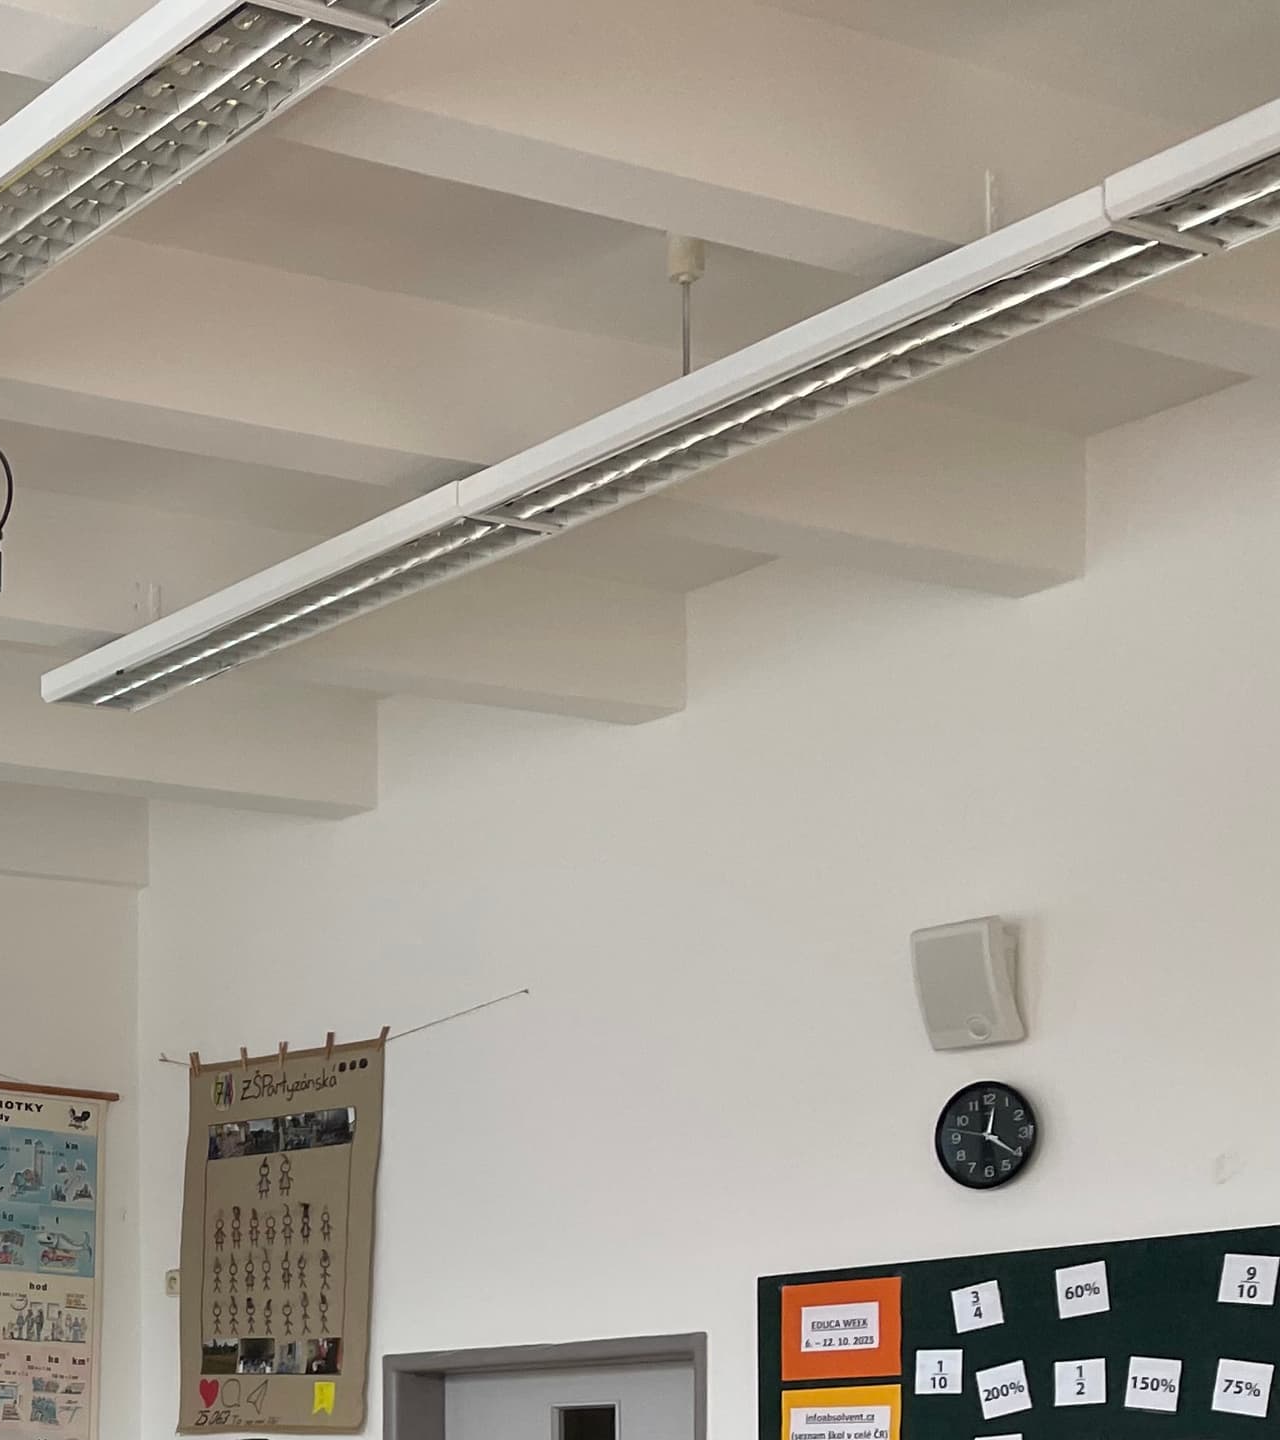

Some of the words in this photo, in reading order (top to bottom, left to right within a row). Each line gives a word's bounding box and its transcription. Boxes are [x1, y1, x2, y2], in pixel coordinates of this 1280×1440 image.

[969, 1100, 979, 1111] 11
[983, 1093, 997, 1106] 12
[1005, 1096, 1009, 1107] 1
[957, 1115, 969, 1127] 10
[1014, 1109, 1024, 1121] 2
[951, 1132, 961, 1145] 9
[1018, 1126, 1029, 1139] 3
[957, 1150, 966, 1161] 8
[968, 1162, 977, 1173] 7
[984, 1165, 995, 1177] 6
[1002, 1160, 1012, 1171] 5
[1246, 1266, 1258, 1281] 9
[29, 1282, 48, 1291] hod
[1065, 1281, 1100, 1300] 60%
[1238, 1284, 1258, 1299] 10
[971, 1291, 980, 1304] 3
[973, 1306, 983, 1319] 4
[811, 1319, 841, 1331] EDUCA
[937, 1360, 944, 1373] 1
[1076, 1365, 1083, 1377] 1
[931, 1376, 948, 1389] 10
[1076, 1382, 1085, 1395] 2
[1131, 1376, 1176, 1393] 150%
[1223, 1379, 1261, 1397] 75%
[983, 1381, 1025, 1402] 200%
